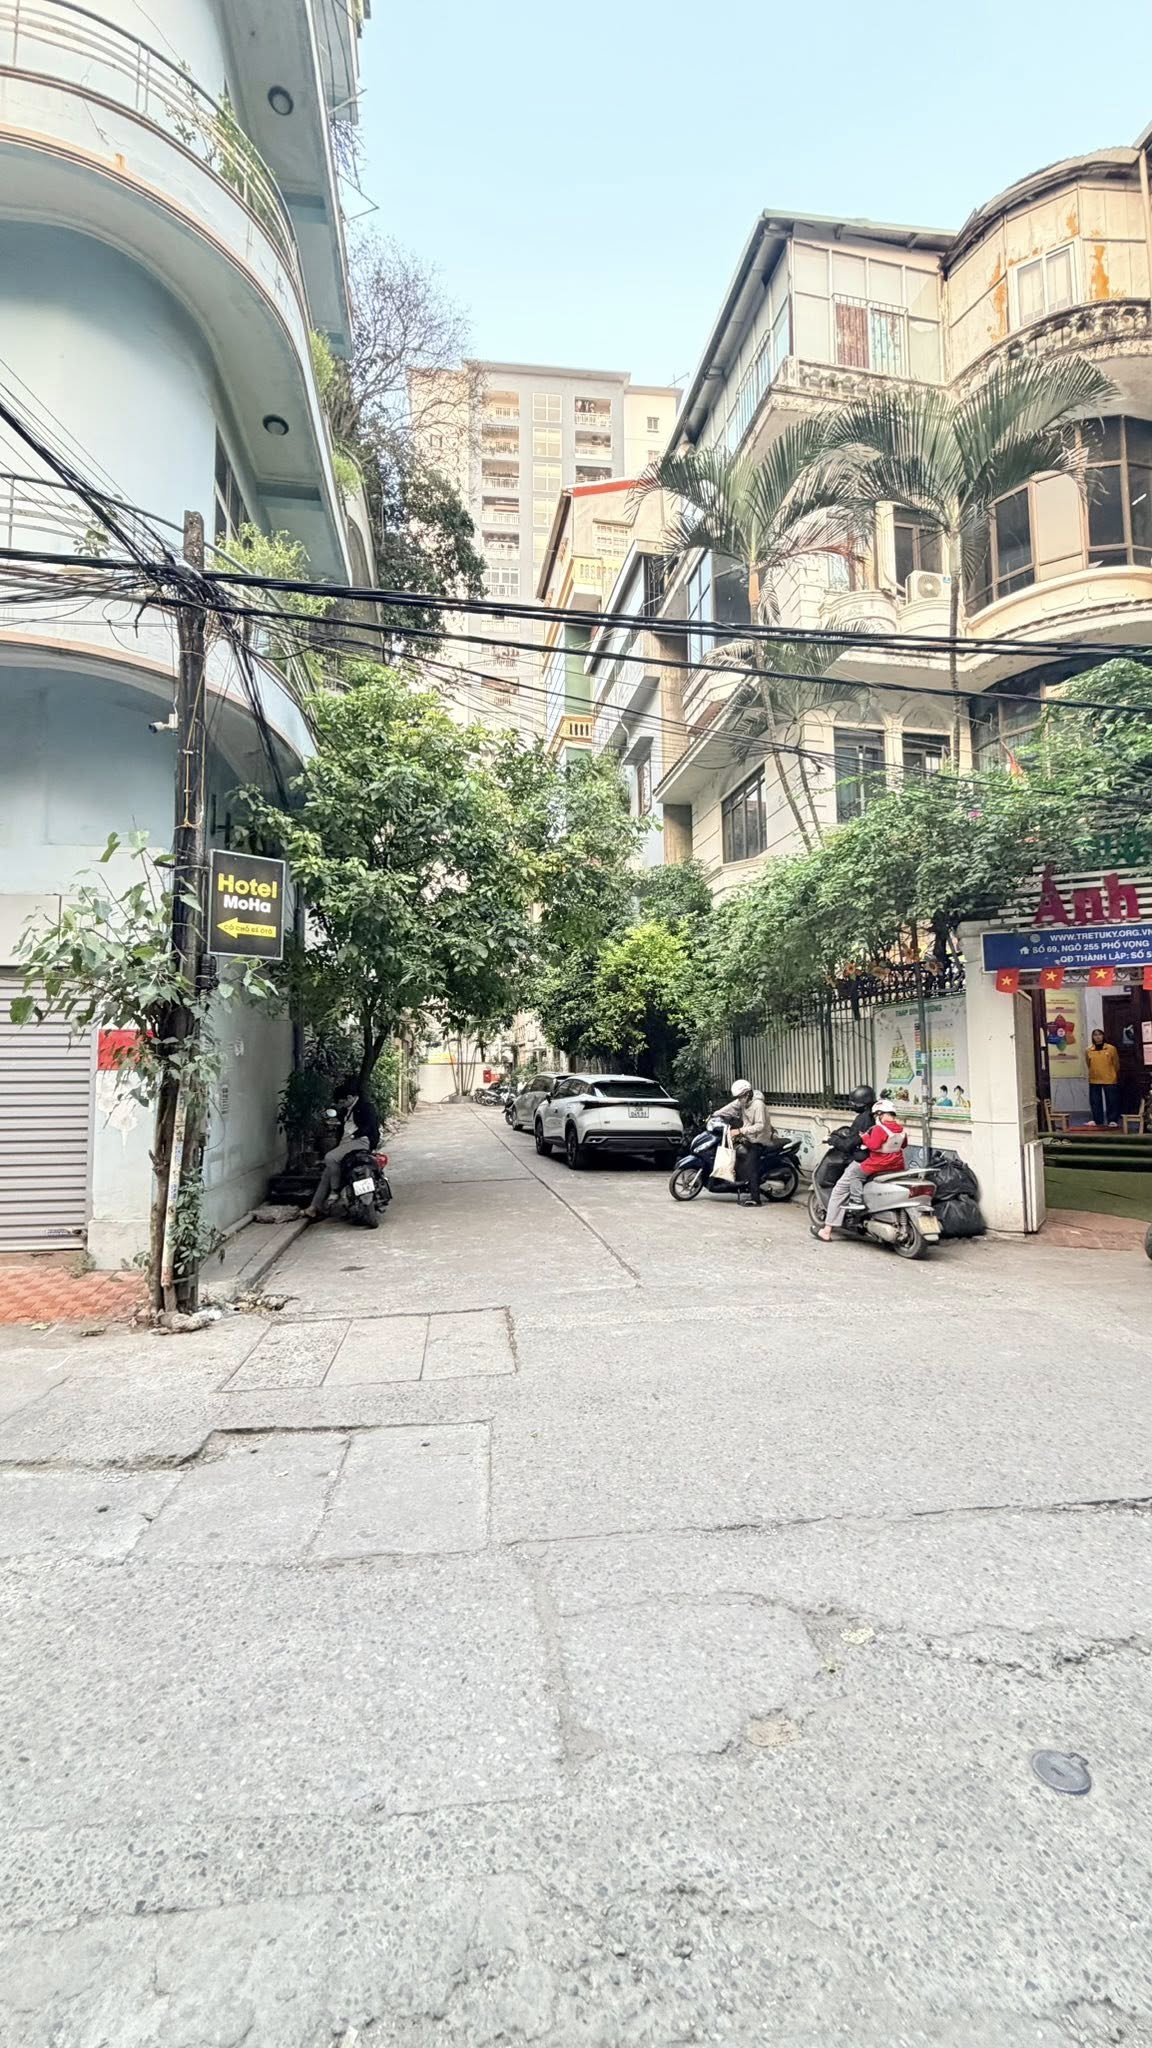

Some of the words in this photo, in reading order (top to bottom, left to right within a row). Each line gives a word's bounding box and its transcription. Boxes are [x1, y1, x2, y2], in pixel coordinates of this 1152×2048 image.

[217, 873, 278, 899] Hotel
[223, 894, 271, 913] MoHa
[1032, 943, 1045, 954] SỐ
[1083, 943, 1100, 951] 255
[1101, 939, 1121, 950] PHỐ
[1122, 939, 1150, 950] VỌNG
[1075, 952, 1107, 962] THÀNH
[1130, 948, 1144, 959] SỐ
